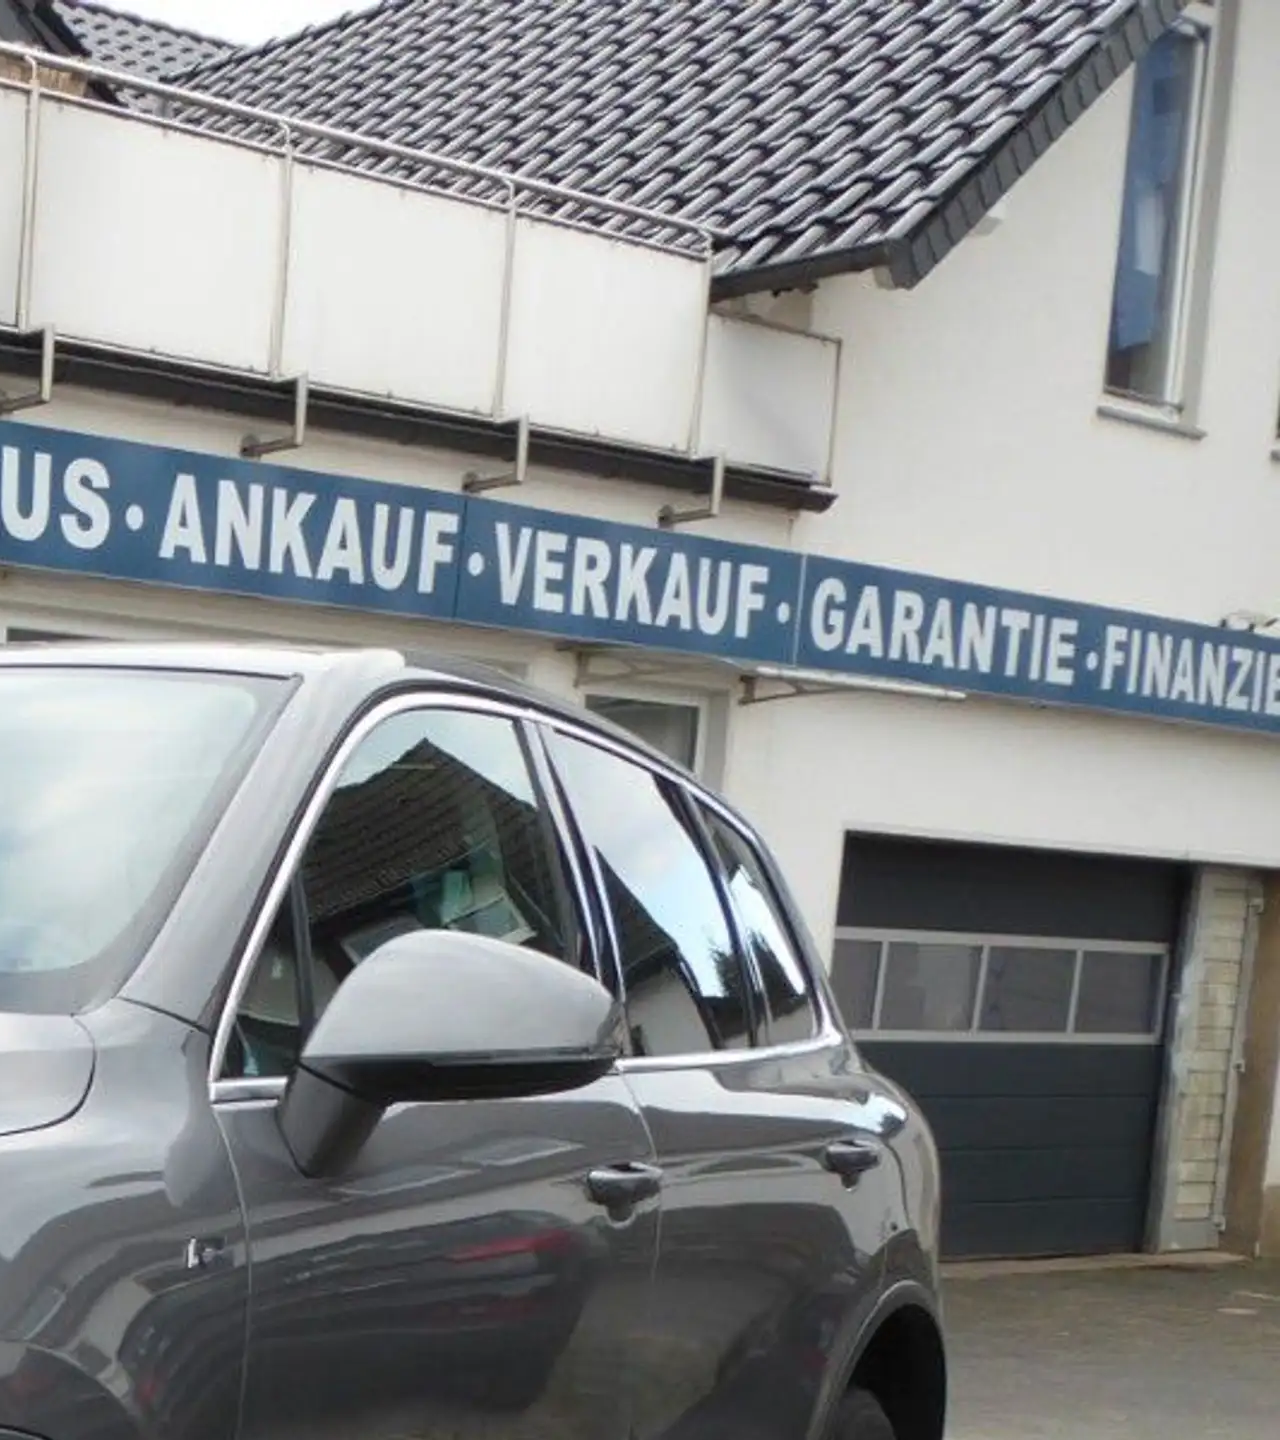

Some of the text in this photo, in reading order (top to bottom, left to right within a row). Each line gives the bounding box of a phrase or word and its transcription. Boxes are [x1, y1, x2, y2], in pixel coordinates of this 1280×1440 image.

[158, 472, 461, 594] ANKAUF
[495, 521, 770, 638] VERKAUF
[810, 576, 1080, 686] GARANTIE
